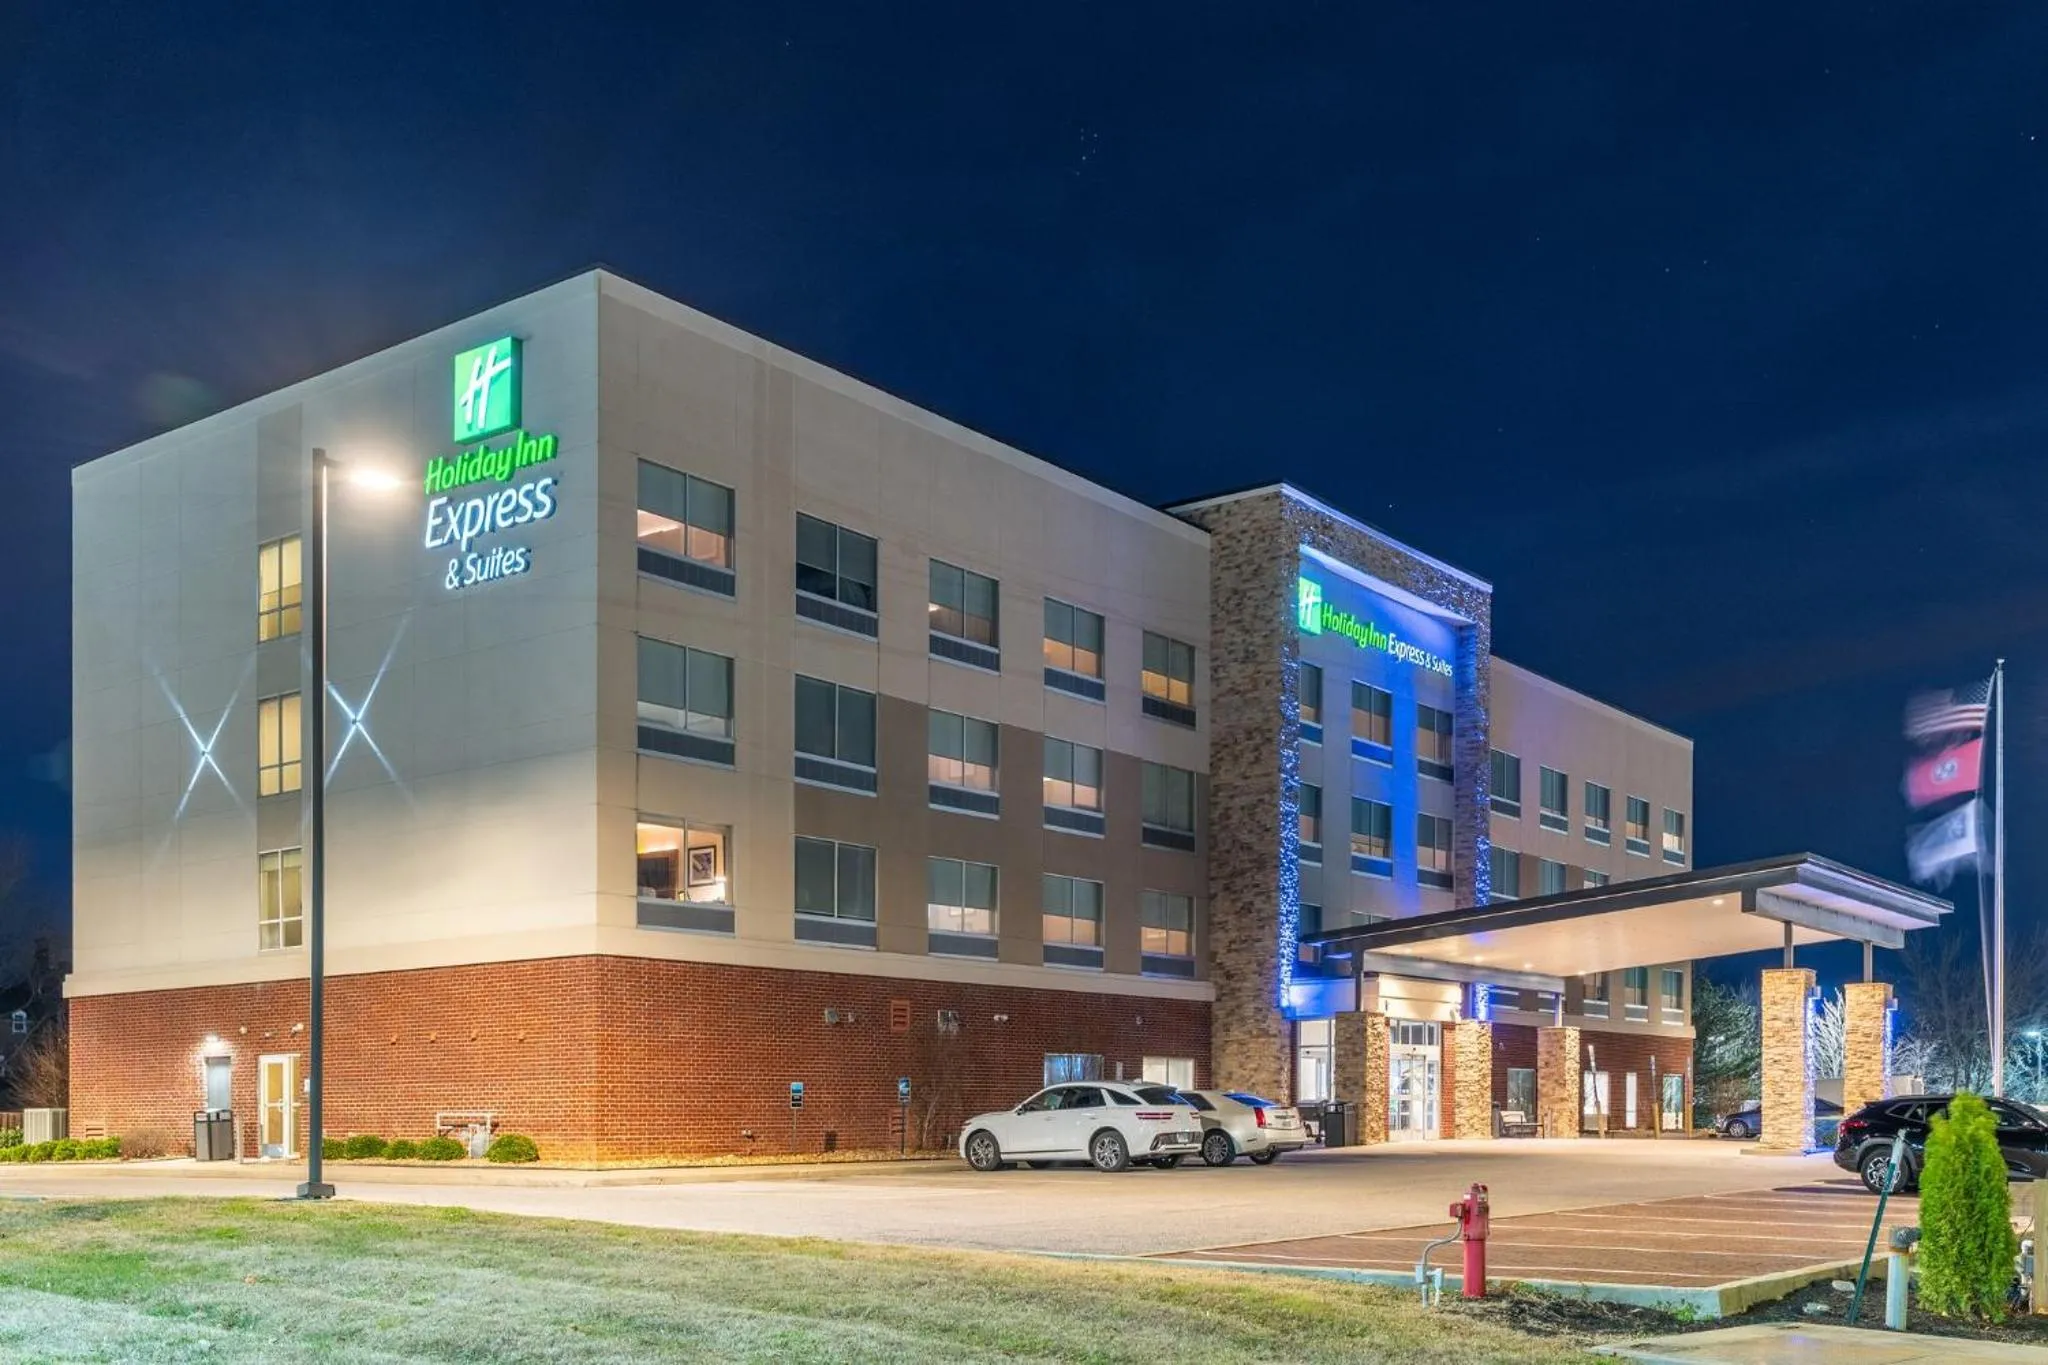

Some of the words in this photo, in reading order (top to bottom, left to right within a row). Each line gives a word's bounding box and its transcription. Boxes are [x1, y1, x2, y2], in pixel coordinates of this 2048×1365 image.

[459, 346, 511, 429] H
[425, 445, 513, 494] Holiday
[516, 430, 556, 467] Inn
[425, 477, 554, 551] Express
[445, 558, 460, 590] &
[464, 547, 528, 584] Suites
[1322, 603, 1368, 648] Holiday
[1369, 622, 1387, 650] Inn
[1387, 632, 1425, 664] Express
[1425, 652, 1431, 669] &
[1432, 656, 1453, 677] Suites
